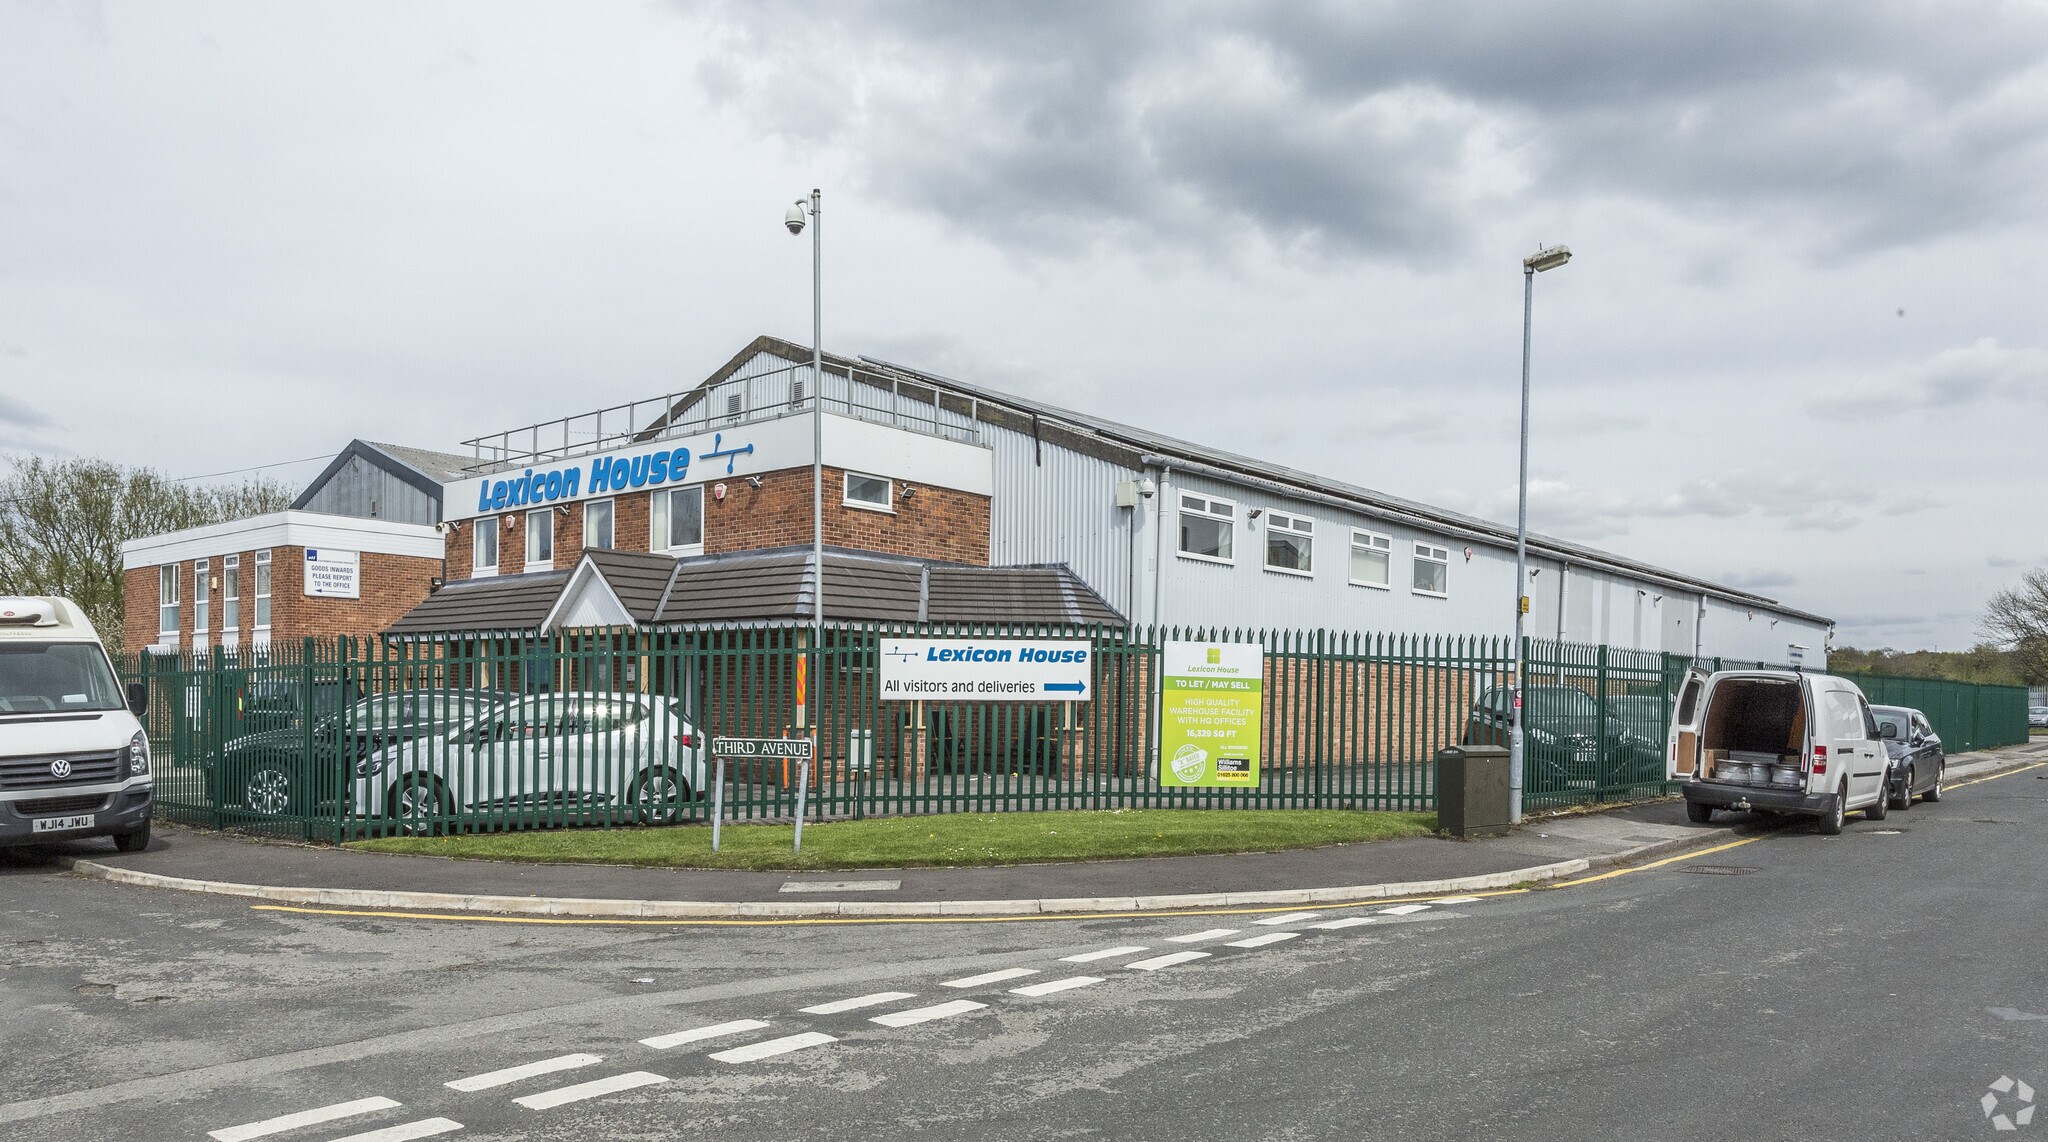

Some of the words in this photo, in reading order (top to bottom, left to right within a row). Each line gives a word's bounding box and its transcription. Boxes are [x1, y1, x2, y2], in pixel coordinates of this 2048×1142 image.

[478, 465, 580, 511] Lexicon
[588, 447, 690, 494] House
[312, 572, 331, 580] PLEASE
[926, 646, 1012, 663] Lexicon
[1018, 648, 1087, 664] House
[1187, 665, 1215, 673] Lexicon
[1217, 666, 1240, 674] House
[884, 680, 900, 692] All
[904, 680, 948, 693] visitors
[951, 681, 974, 693] and
[977, 681, 1035, 693] deliveries
[1188, 680, 1204, 688] LET
[1211, 681, 1229, 689] MAY
[1231, 681, 1250, 689] SELL
[1185, 698, 1204, 706] HIGH
[1206, 699, 1240, 707] QUALITY
[1169, 707, 1219, 715] WAREHOUSE
[1221, 708, 1255, 716] FACILITY
[1186, 729, 1211, 738] 16,329
[1226, 730, 1237, 738] FT
[716, 741, 755, 754] THIRD
[761, 742, 809, 756] AVENUE
[40, 818, 65, 830] WJ14
[68, 816, 88, 828] JWU
